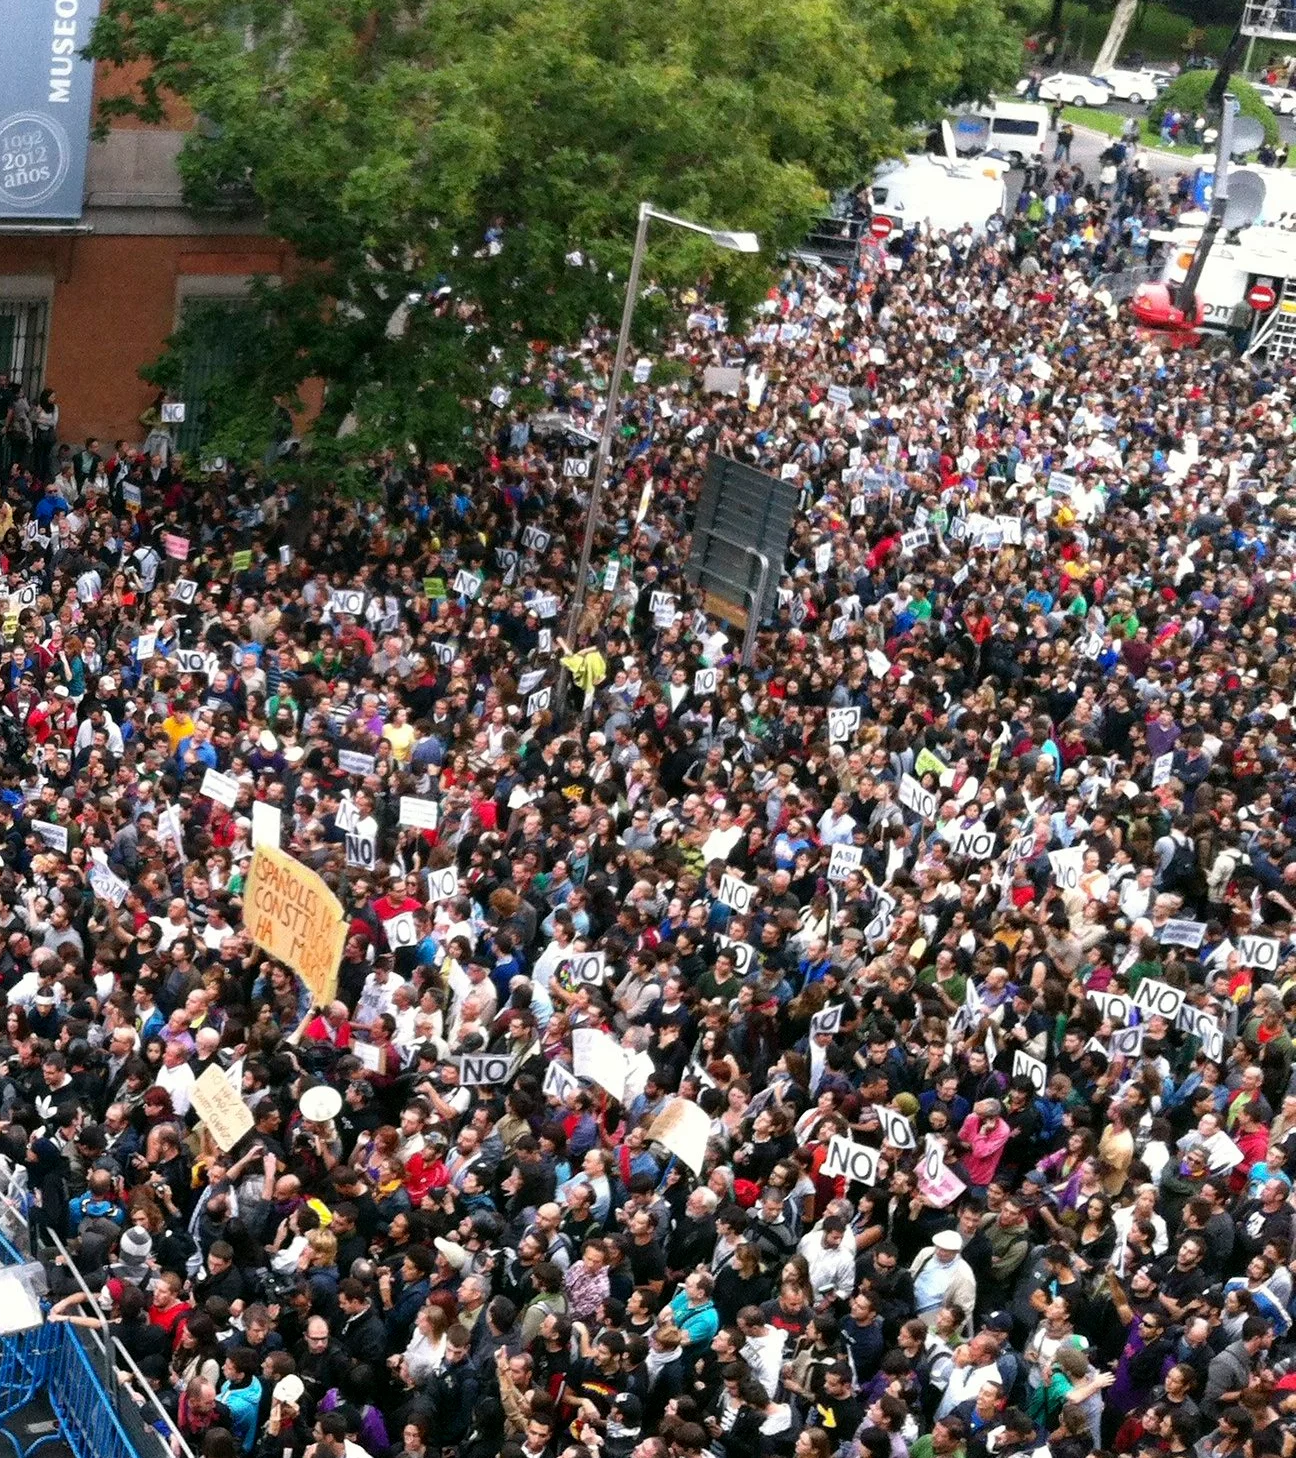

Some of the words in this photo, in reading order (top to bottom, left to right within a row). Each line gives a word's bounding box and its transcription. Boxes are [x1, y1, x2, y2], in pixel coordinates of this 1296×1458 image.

[48, 0, 79, 103] MUSEO
[3, 130, 44, 154] 1992
[2, 148, 48, 171] 2012
[4, 165, 51, 188] años
[164, 405, 182, 420] NO
[566, 463, 587, 476] NO
[524, 529, 547, 549] NO
[496, 552, 516, 567] NO
[177, 581, 195, 600] NO
[456, 573, 478, 595] NO
[335, 592, 361, 611] NO
[180, 652, 204, 671] NO
[696, 672, 714, 690] NO
[528, 691, 549, 714] NO
[911, 788, 932, 816] NO
[348, 837, 373, 864] NO
[957, 833, 992, 855] NO
[1011, 837, 1033, 860] NO
[431, 870, 454, 897] NO
[722, 879, 748, 910] NO
[255, 914, 273, 947] HA
[1241, 940, 1275, 965] NO
[1136, 982, 1180, 1015] NO
[462, 1057, 508, 1083] NO
[830, 1141, 873, 1180] NO
